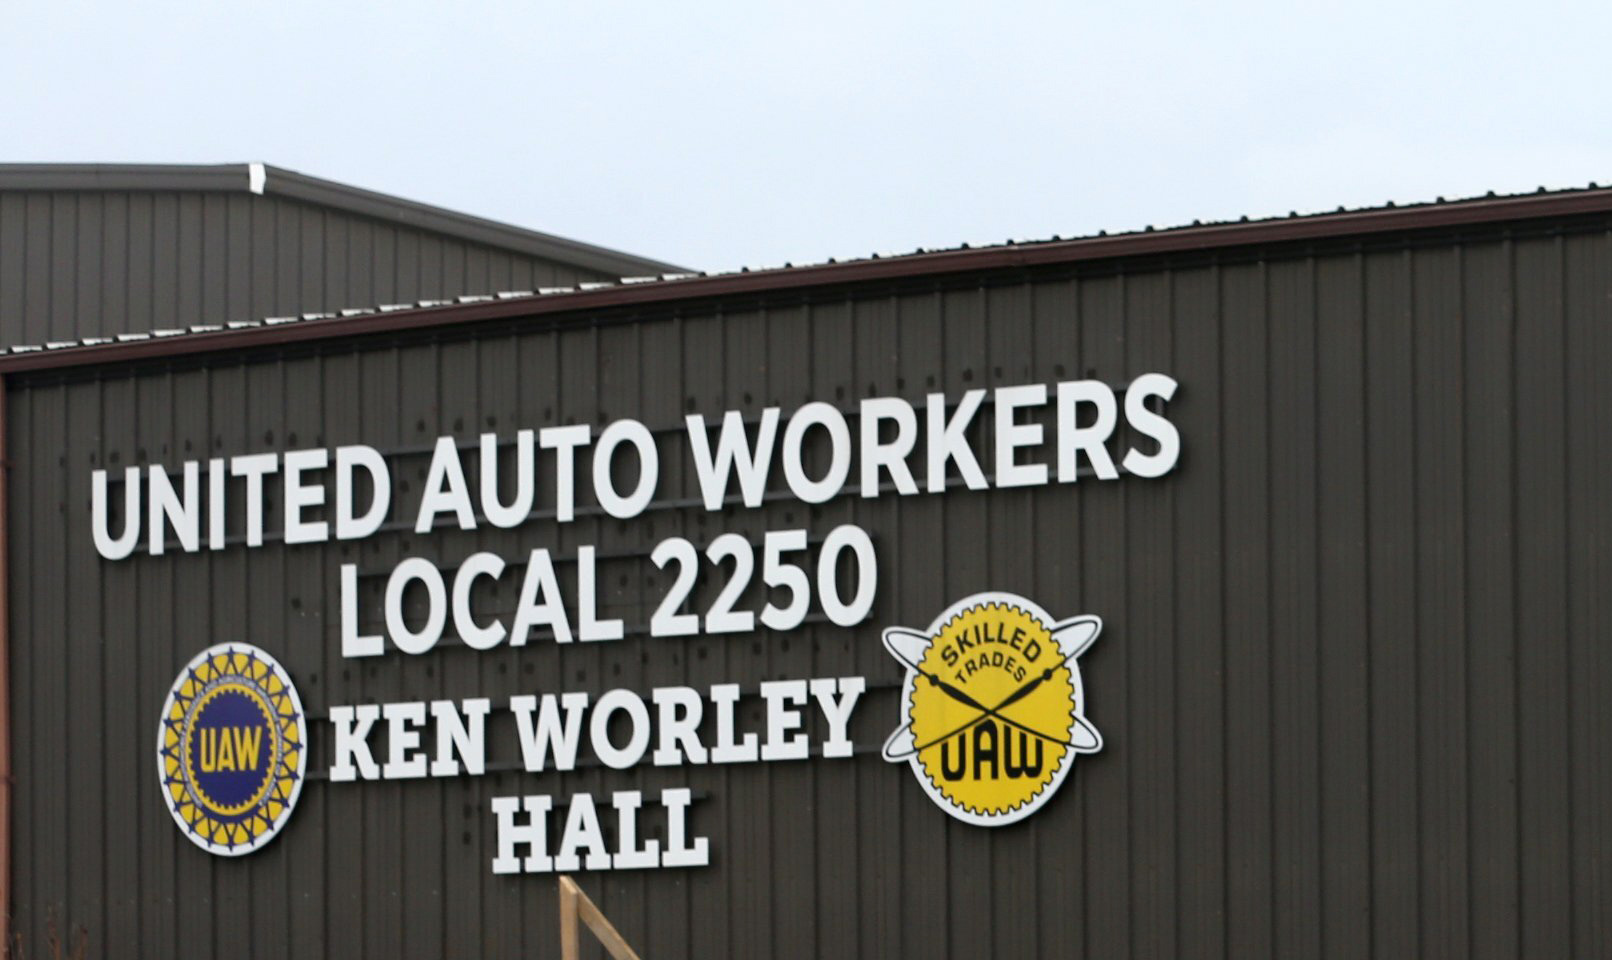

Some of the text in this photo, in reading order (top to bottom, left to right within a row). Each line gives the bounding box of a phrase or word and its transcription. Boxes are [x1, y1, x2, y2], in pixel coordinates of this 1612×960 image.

[92, 373, 1180, 560] UNITED AUTO WORKERS
[341, 524, 877, 658] LOCAL 2250
[941, 622, 1042, 667] SKILLED
[954, 651, 1027, 684] TRADES
[200, 726, 263, 772] UAW
[329, 697, 491, 782] KEN
[509, 676, 866, 772] WORLEY
[941, 718, 1043, 782] UAW
[491, 787, 709, 875] HALL
